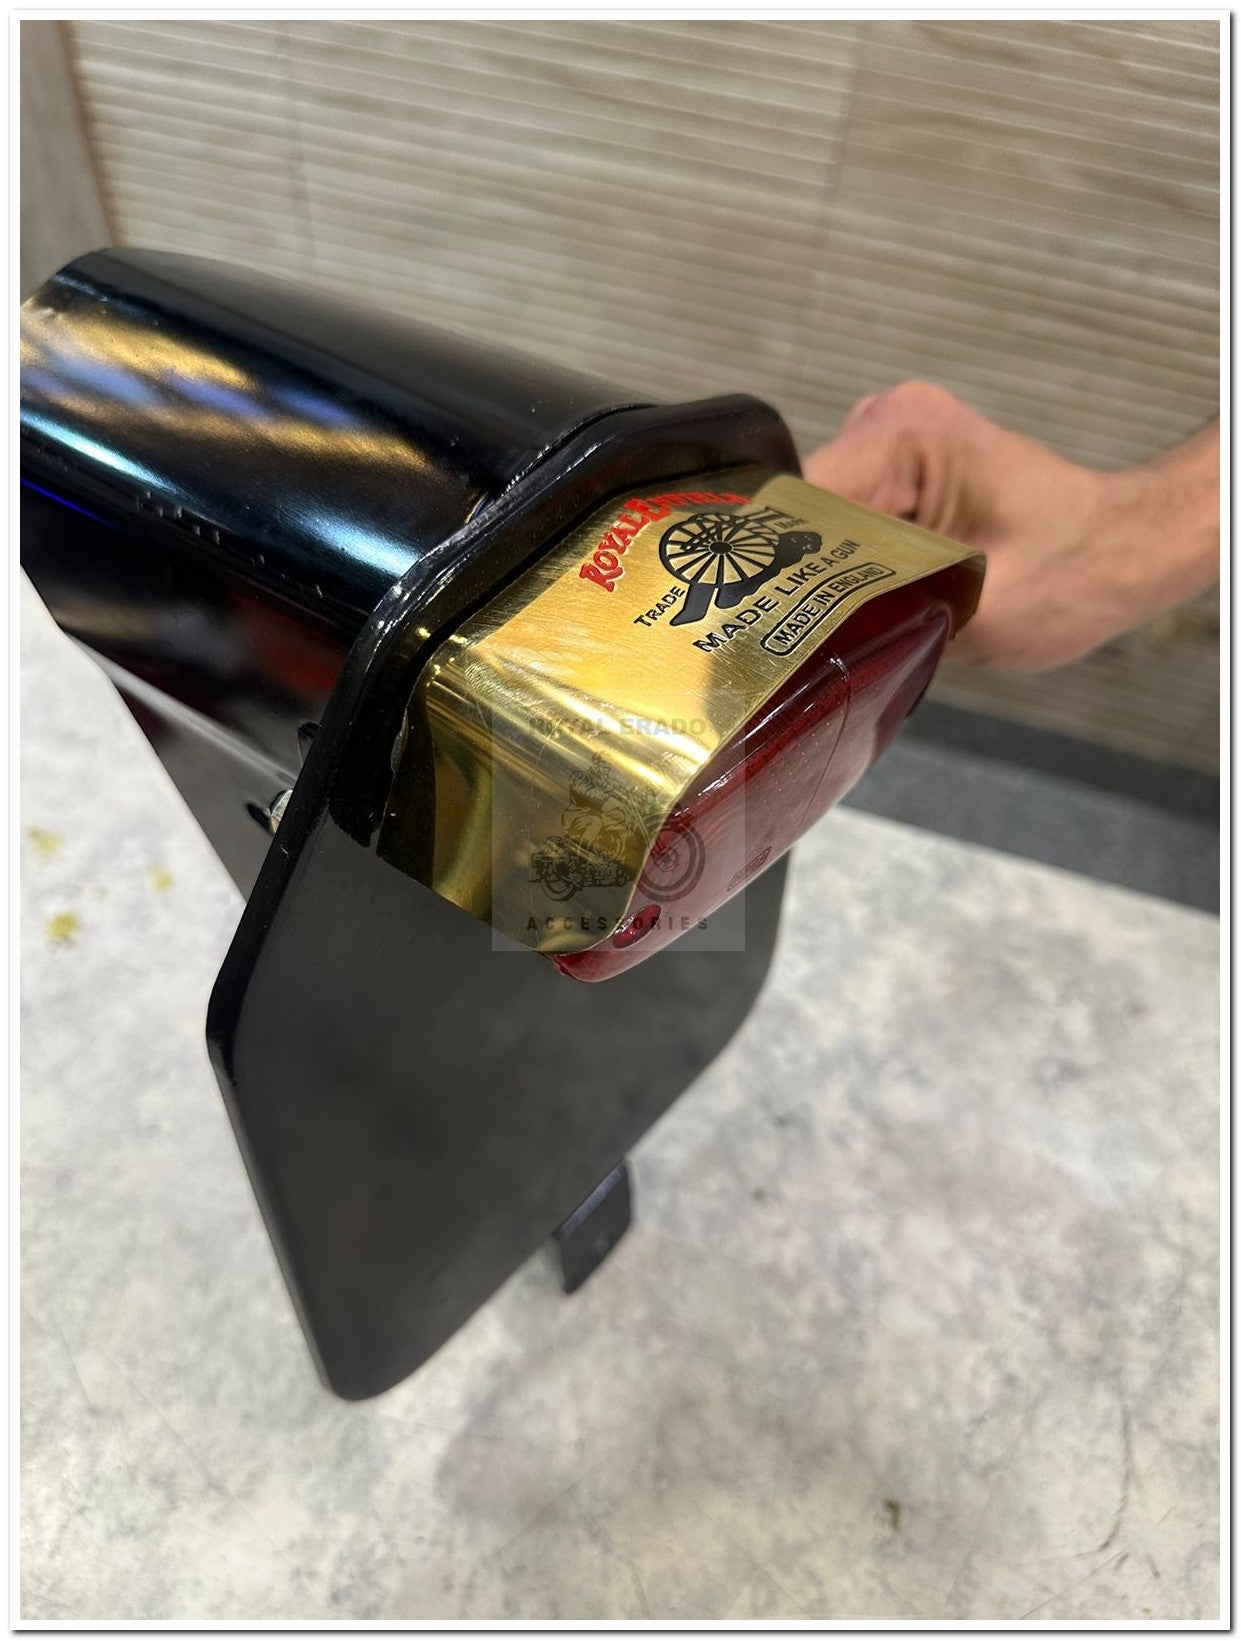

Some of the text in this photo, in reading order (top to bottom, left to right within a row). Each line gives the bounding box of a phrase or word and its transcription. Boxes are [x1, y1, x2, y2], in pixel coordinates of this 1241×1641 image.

[579, 512, 650, 593] ROYAL
[633, 586, 686, 626] TRADE
[692, 539, 861, 653] MADE LIKE A GUN
[773, 566, 884, 645] MADE IN ENGLAND
